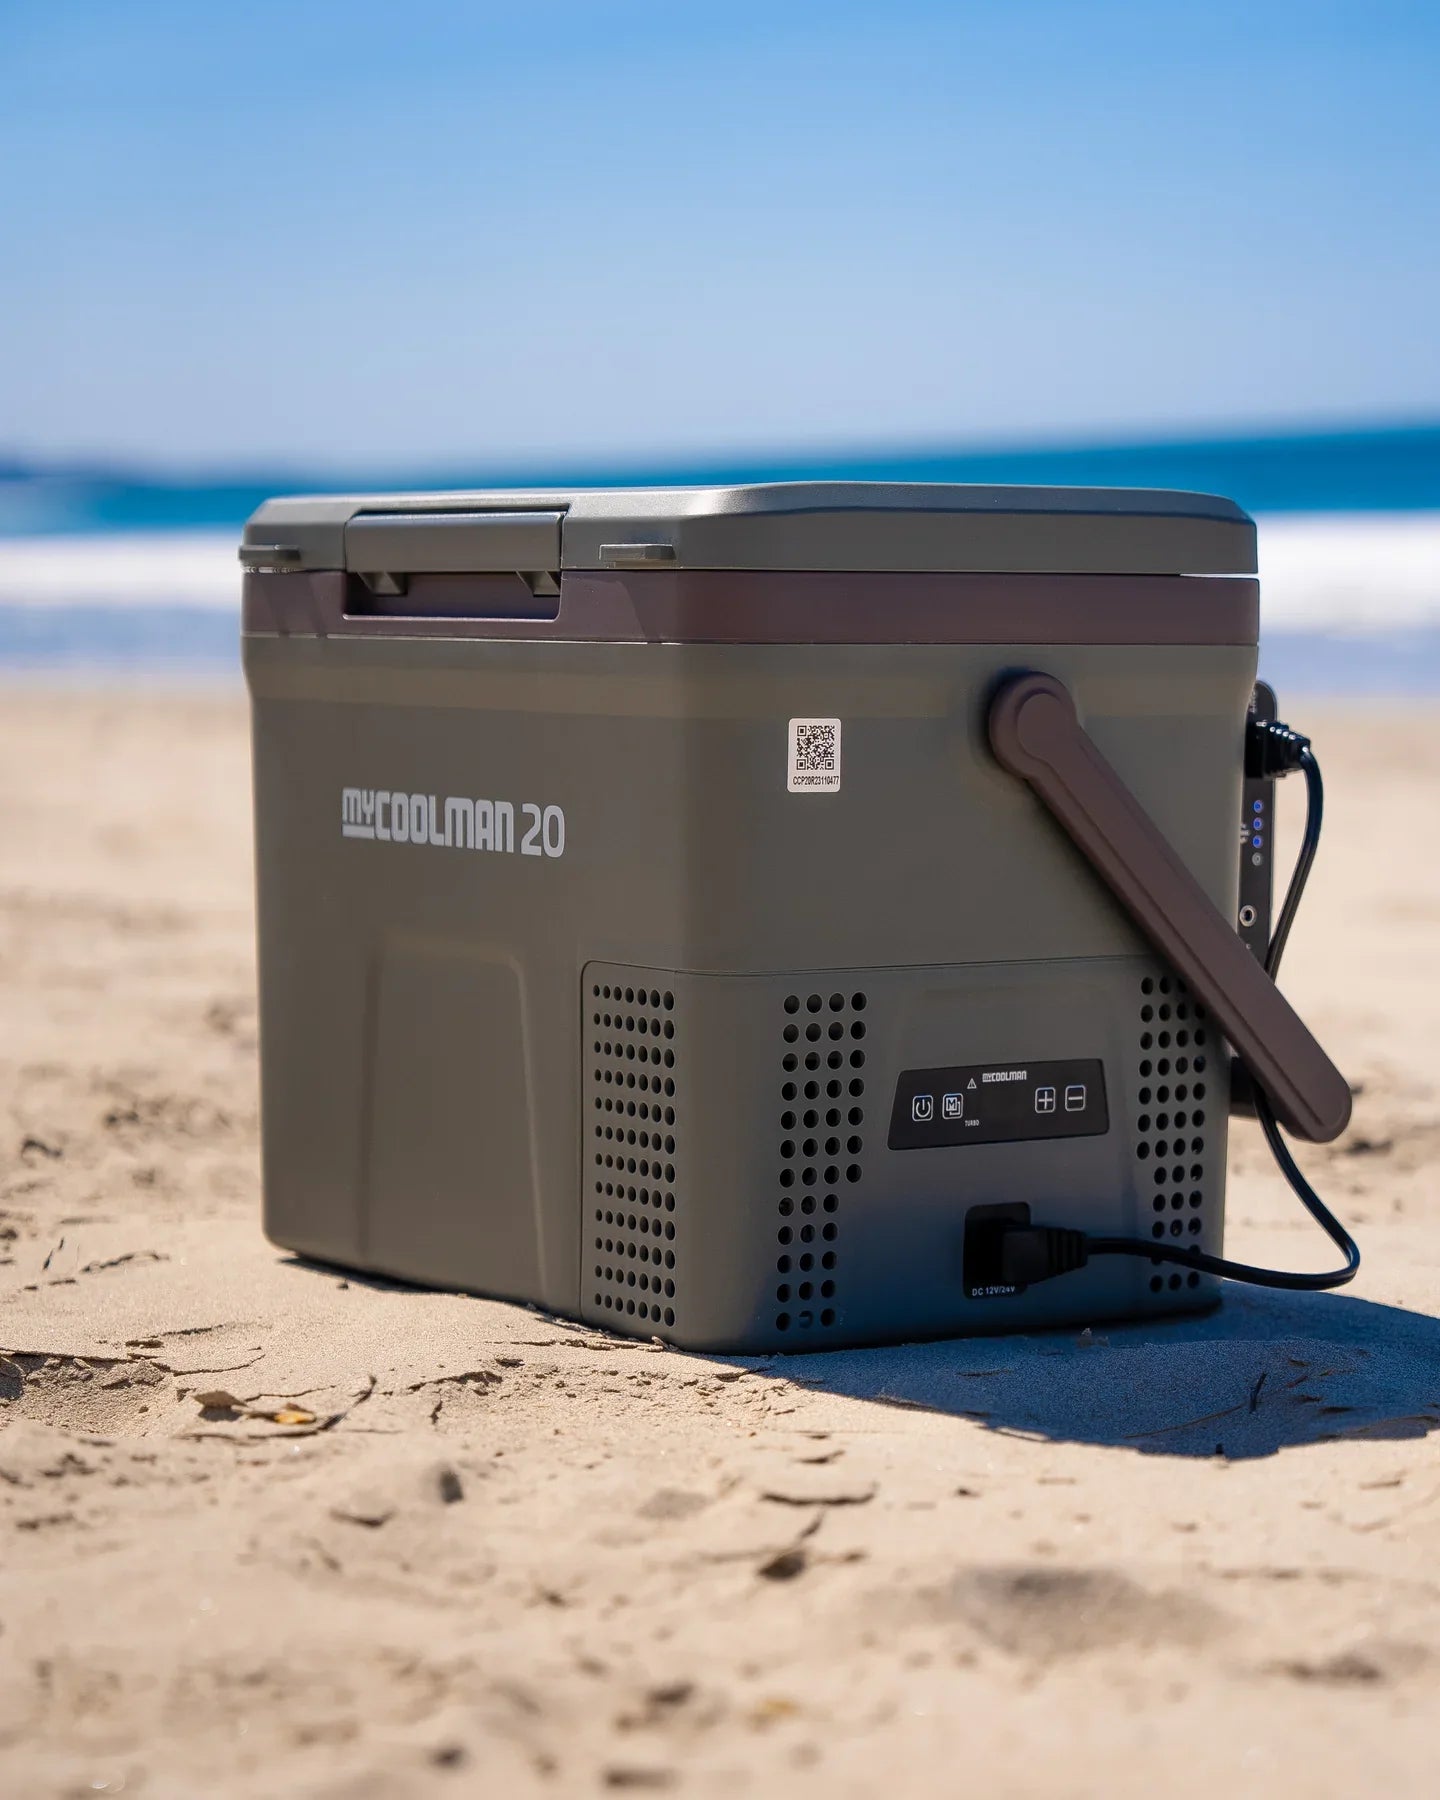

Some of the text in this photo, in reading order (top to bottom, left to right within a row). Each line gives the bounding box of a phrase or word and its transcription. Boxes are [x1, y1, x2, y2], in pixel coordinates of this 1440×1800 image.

[342, 787, 564, 858] MYCOOLMAN 20
[982, 1070, 1027, 1082] MYCOOLMAN
[972, 1286, 1015, 1296] DC 12V/24V
